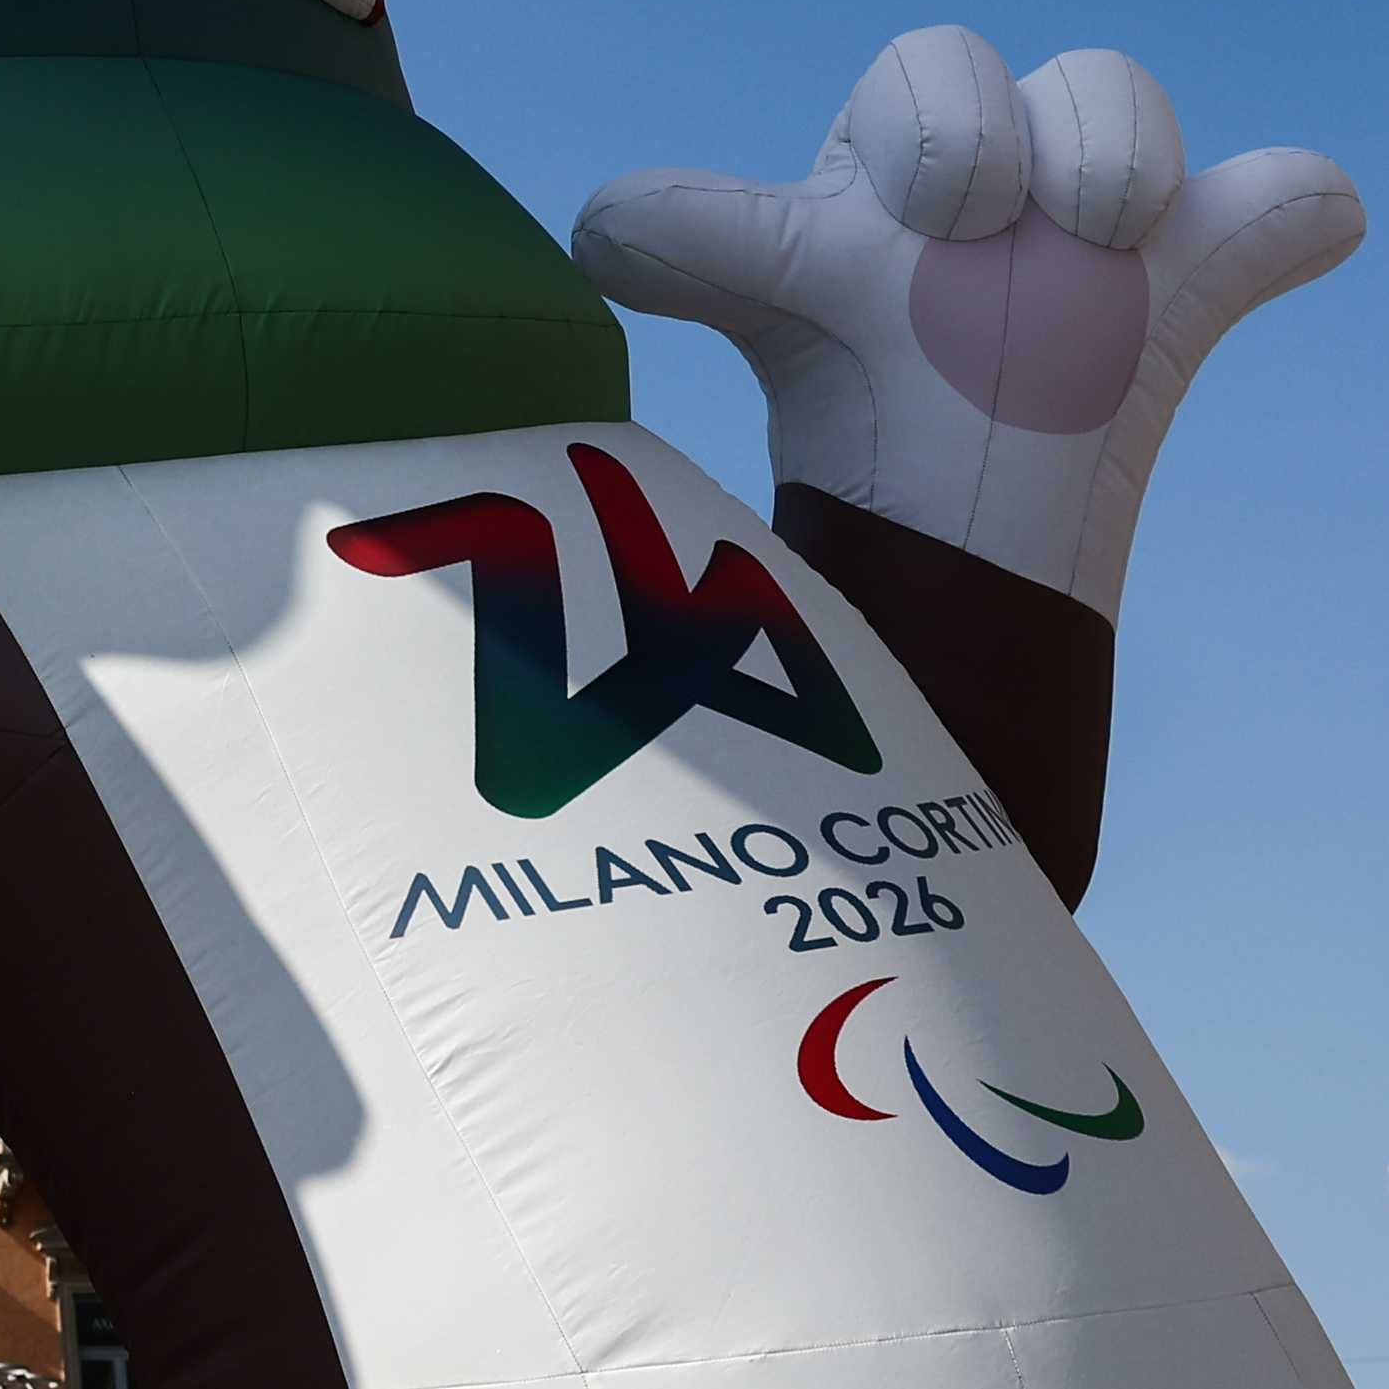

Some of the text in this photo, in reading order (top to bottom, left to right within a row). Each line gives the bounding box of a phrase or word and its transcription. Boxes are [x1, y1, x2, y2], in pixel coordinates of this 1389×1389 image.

[389, 788, 1021, 938] MILANO CORTIN
[764, 876, 964, 953] 2026
